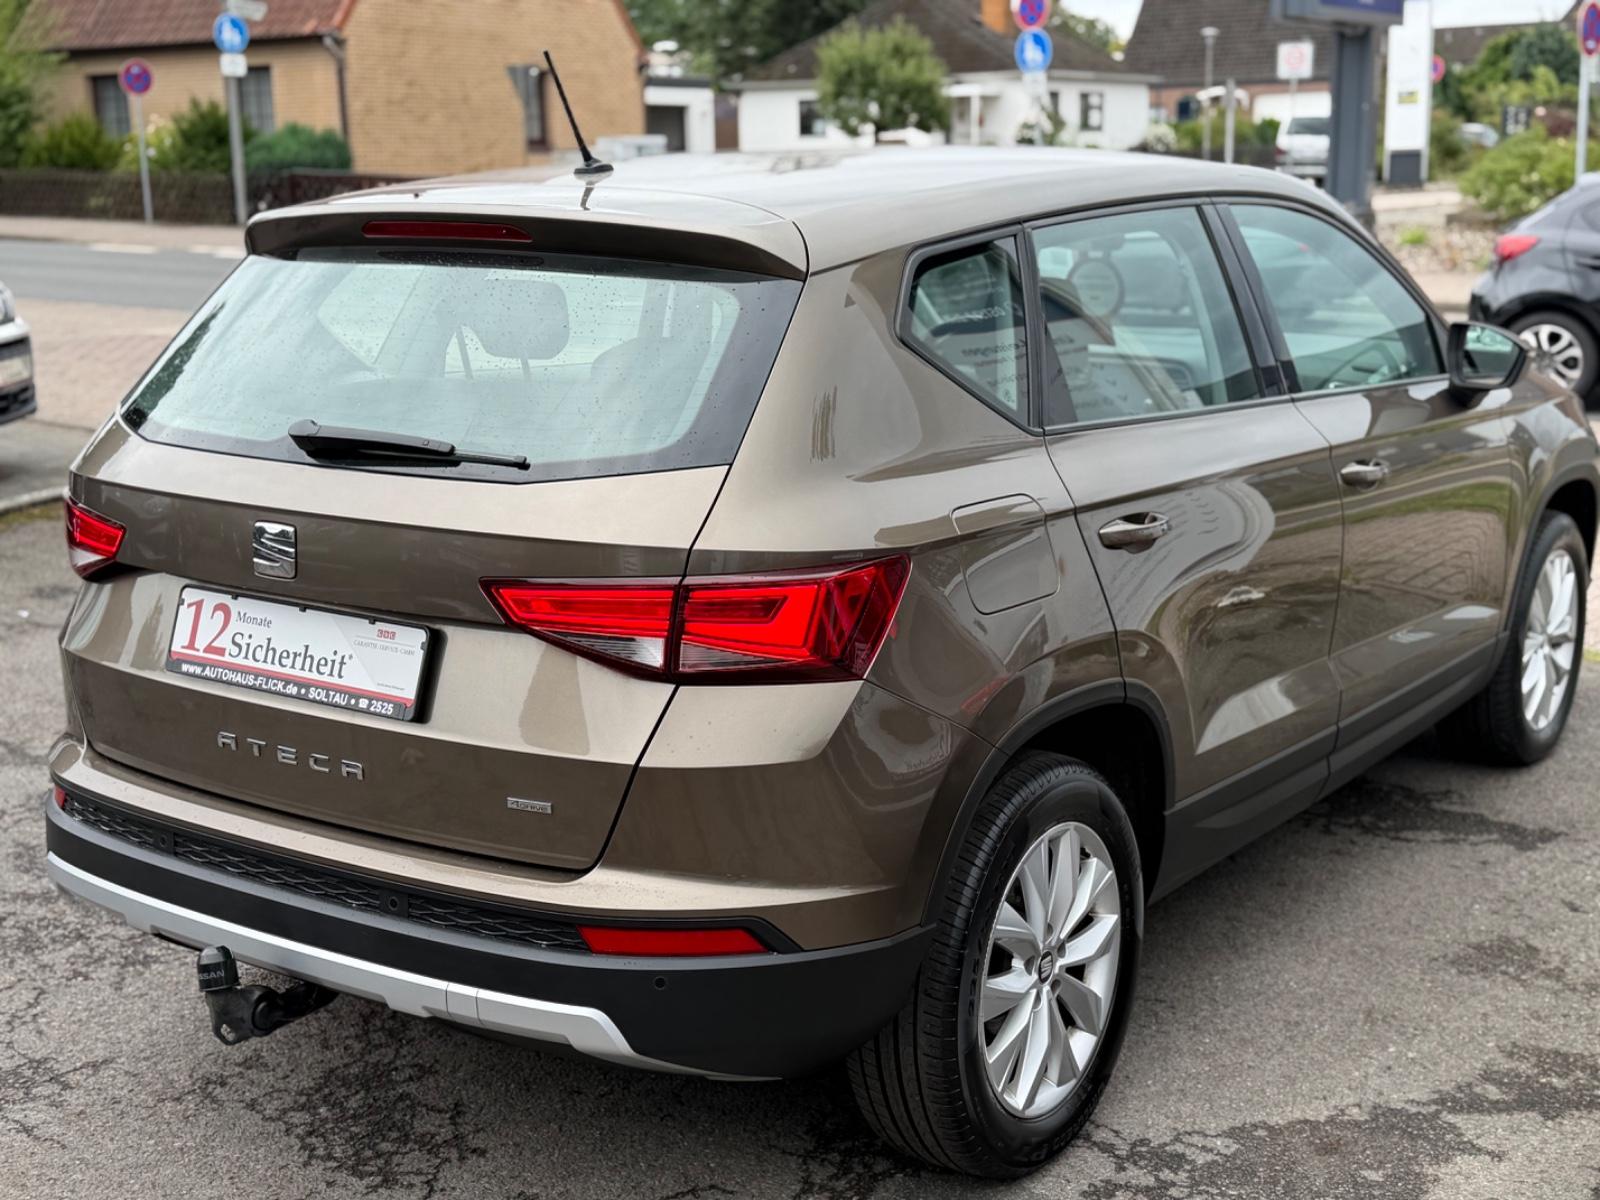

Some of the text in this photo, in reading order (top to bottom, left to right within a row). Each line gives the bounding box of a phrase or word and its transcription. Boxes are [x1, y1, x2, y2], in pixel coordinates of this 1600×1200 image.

[180, 598, 232, 656] 12
[235, 610, 273, 629] Monate
[181, 661, 298, 696] www.AUTOHAUS-FLICK.de
[308, 687, 349, 705] SOLTAU
[369, 699, 394, 715] 2525
[216, 731, 365, 781] ATECA
